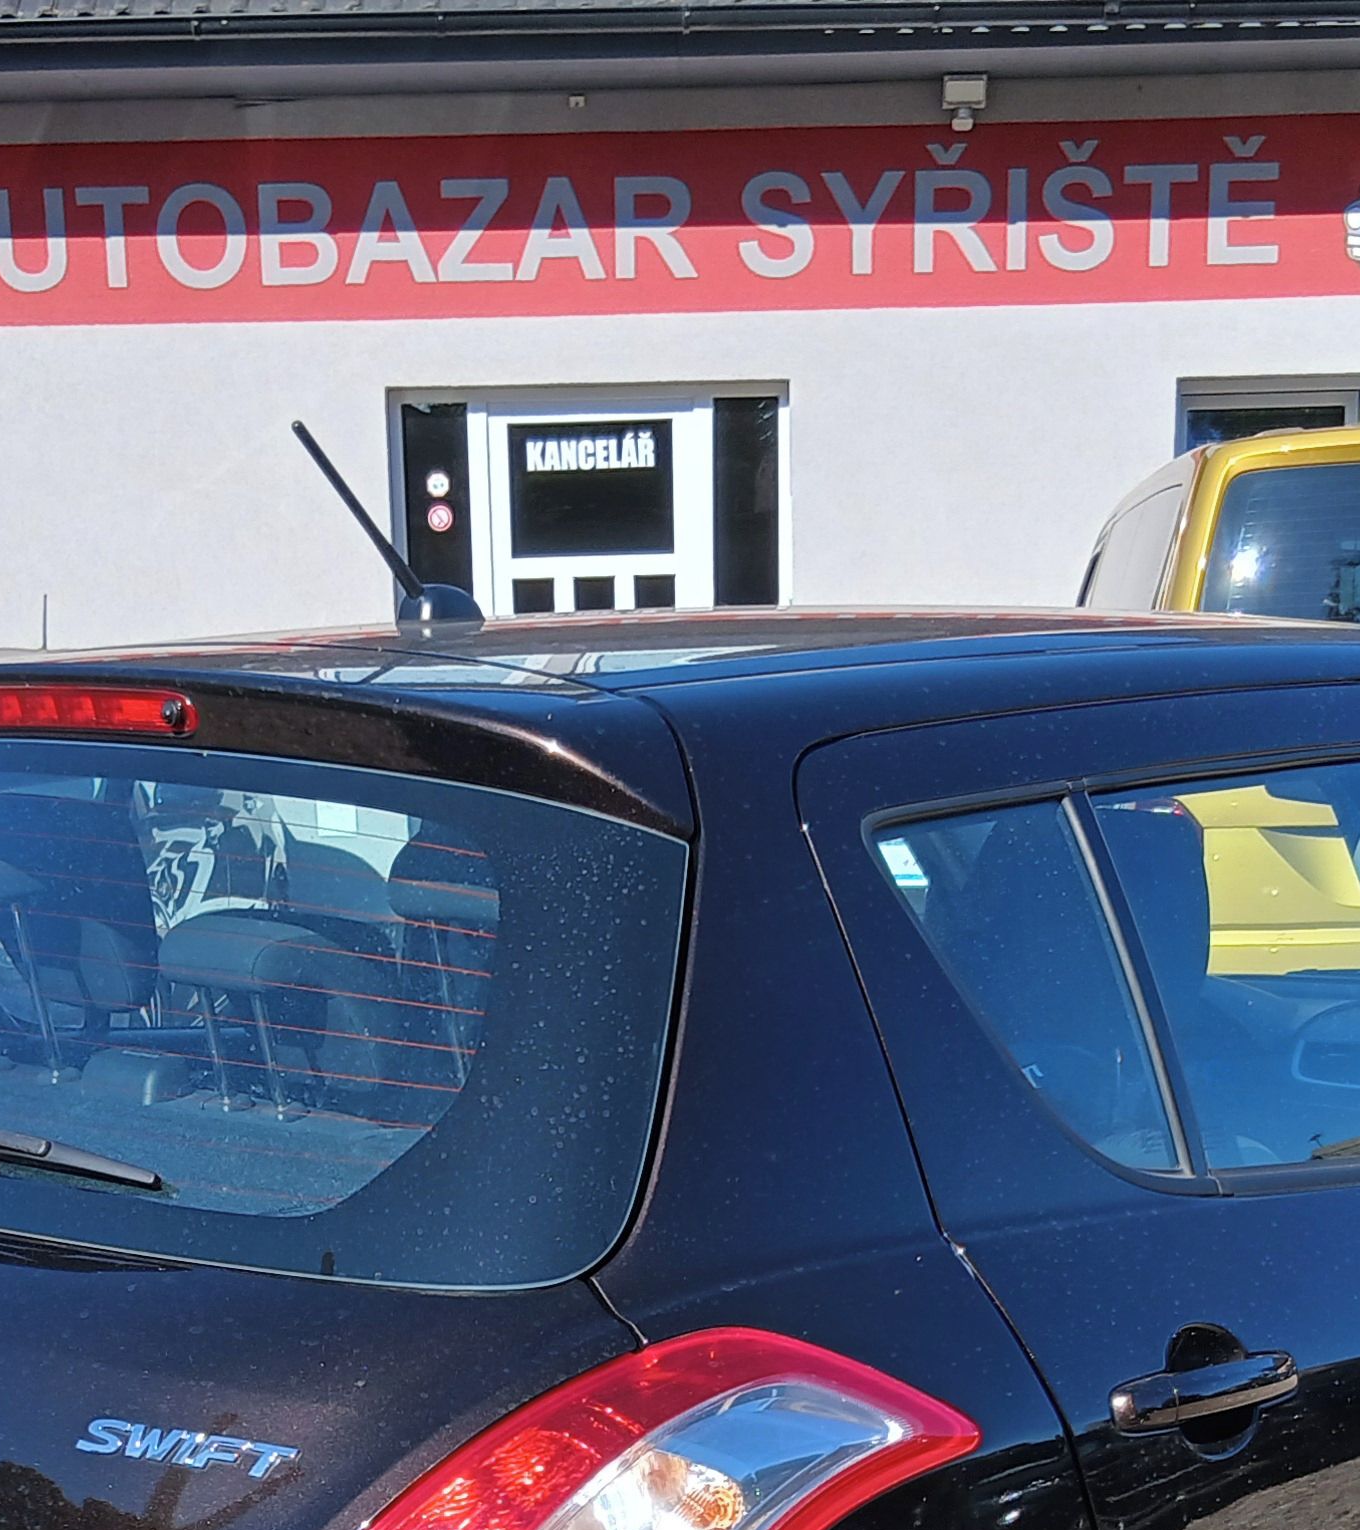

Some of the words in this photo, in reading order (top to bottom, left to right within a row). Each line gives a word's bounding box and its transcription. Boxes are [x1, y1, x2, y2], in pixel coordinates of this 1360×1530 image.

[738, 135, 1281, 279] SYŘIŠTĚ
[525, 431, 657, 473] KANCELÁŘ
[76, 1418, 300, 1480] SWIFT
